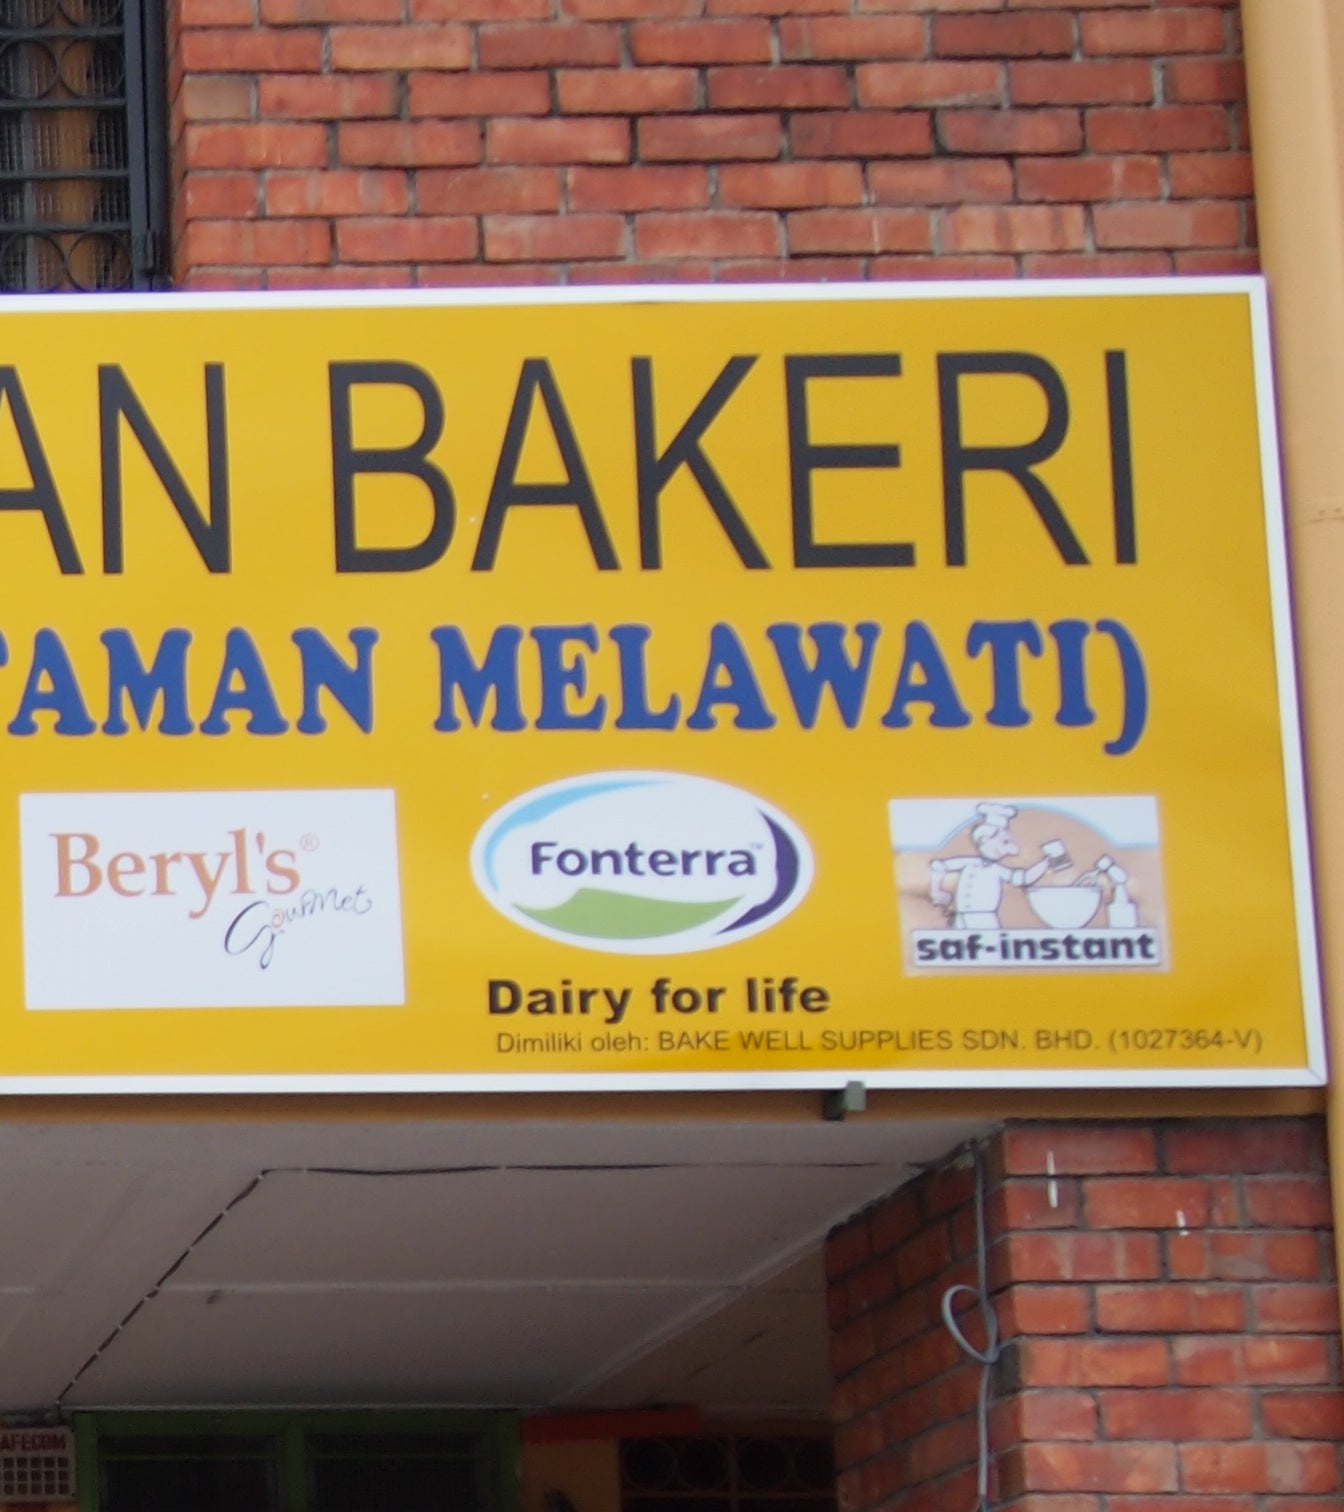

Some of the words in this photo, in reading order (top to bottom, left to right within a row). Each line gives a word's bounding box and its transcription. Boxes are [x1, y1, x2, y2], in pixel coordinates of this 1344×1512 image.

[329, 350, 1137, 573] BAKERI
[432, 619, 1148, 756] MELAWATI)
[49, 826, 301, 920] Beryl's
[530, 840, 757, 878] Fonterra
[916, 931, 1156, 962] saf-instant
[487, 978, 632, 1025] Dairy
[650, 977, 726, 1015] for
[745, 976, 830, 1014] life
[496, 1031, 583, 1054] Dimiliki
[589, 1031, 650, 1053] oleh:
[656, 1029, 732, 1053] BAKE
[736, 1029, 814, 1053] WELL
[819, 1027, 955, 1053] SUPPLIES
[961, 1027, 1027, 1052] SDN.
[1033, 1026, 1102, 1052] BHD.
[1108, 1026, 1265, 1055] (1027364-V)
